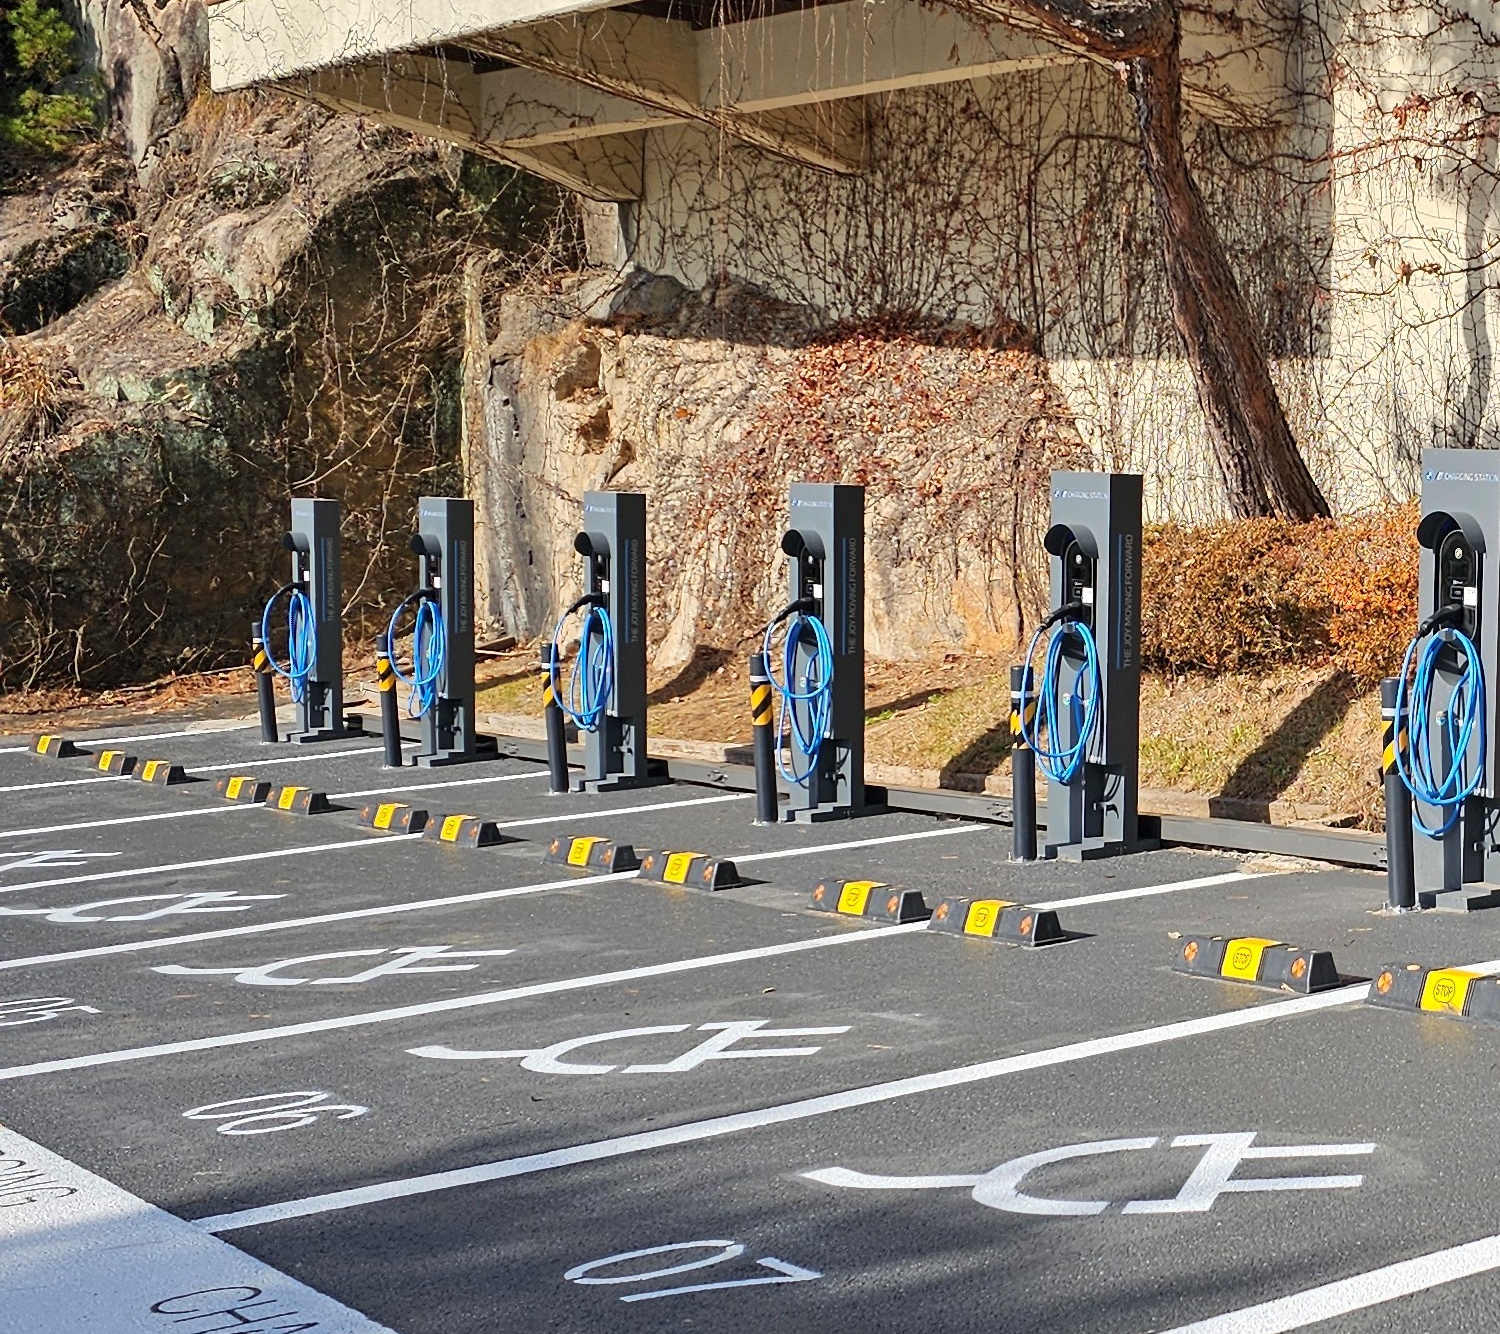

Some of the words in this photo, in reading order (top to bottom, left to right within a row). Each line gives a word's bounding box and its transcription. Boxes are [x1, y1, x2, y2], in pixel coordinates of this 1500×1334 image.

[1125, 534, 1133, 585] FORWARD
[1124, 586, 1133, 626] MOVING
[1124, 627, 1132, 647] JOY
[182, 1091, 369, 1135] 06
[563, 1239, 824, 1302] 07
